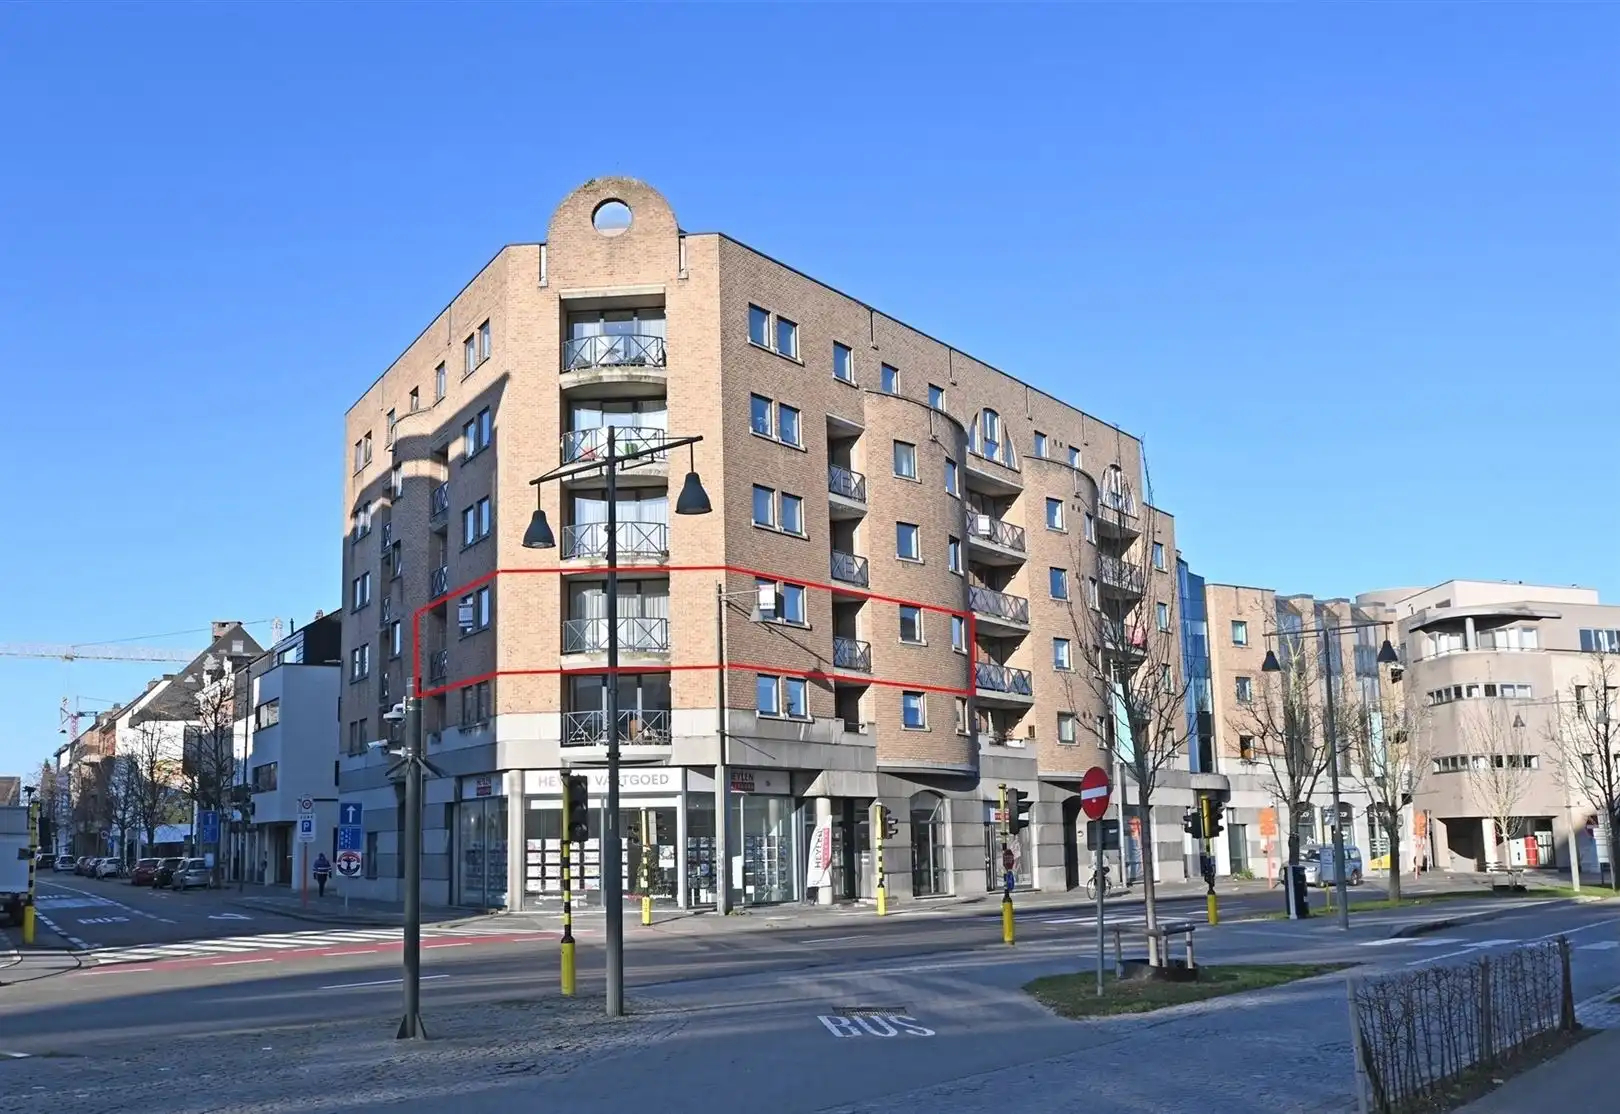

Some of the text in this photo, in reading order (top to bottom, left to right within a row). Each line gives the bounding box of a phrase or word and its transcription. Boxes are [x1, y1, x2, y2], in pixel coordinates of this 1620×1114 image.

[595, 774, 669, 786] VATGOED
[731, 772, 754, 781] EYLEN
[303, 821, 310, 831] P
[817, 1015, 936, 1038] BUS
